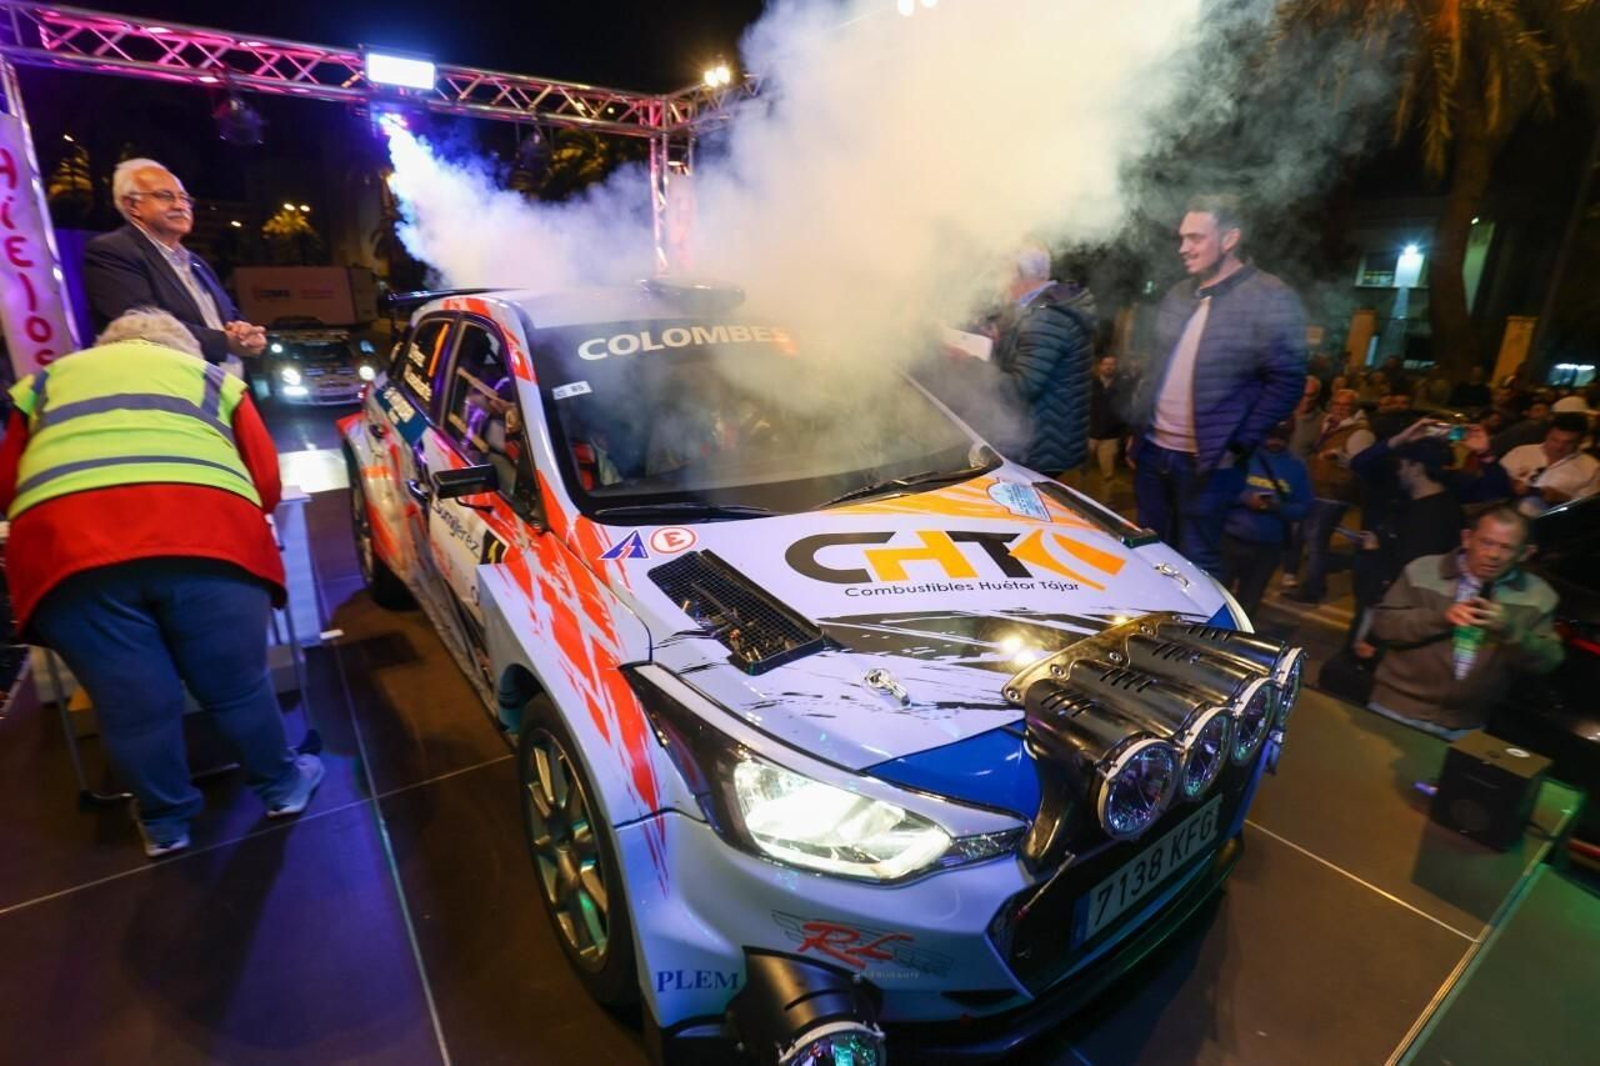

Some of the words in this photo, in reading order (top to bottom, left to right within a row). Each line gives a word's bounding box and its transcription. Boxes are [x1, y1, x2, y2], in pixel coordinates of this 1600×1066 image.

[845, 580, 975, 597] Combustibles
[979, 581, 1035, 591] Huétor
[1039, 580, 1080, 591] Tájar
[1094, 847, 1164, 926] 7138
[1169, 809, 1215, 868] KFG
[657, 969, 739, 993] PLEM
